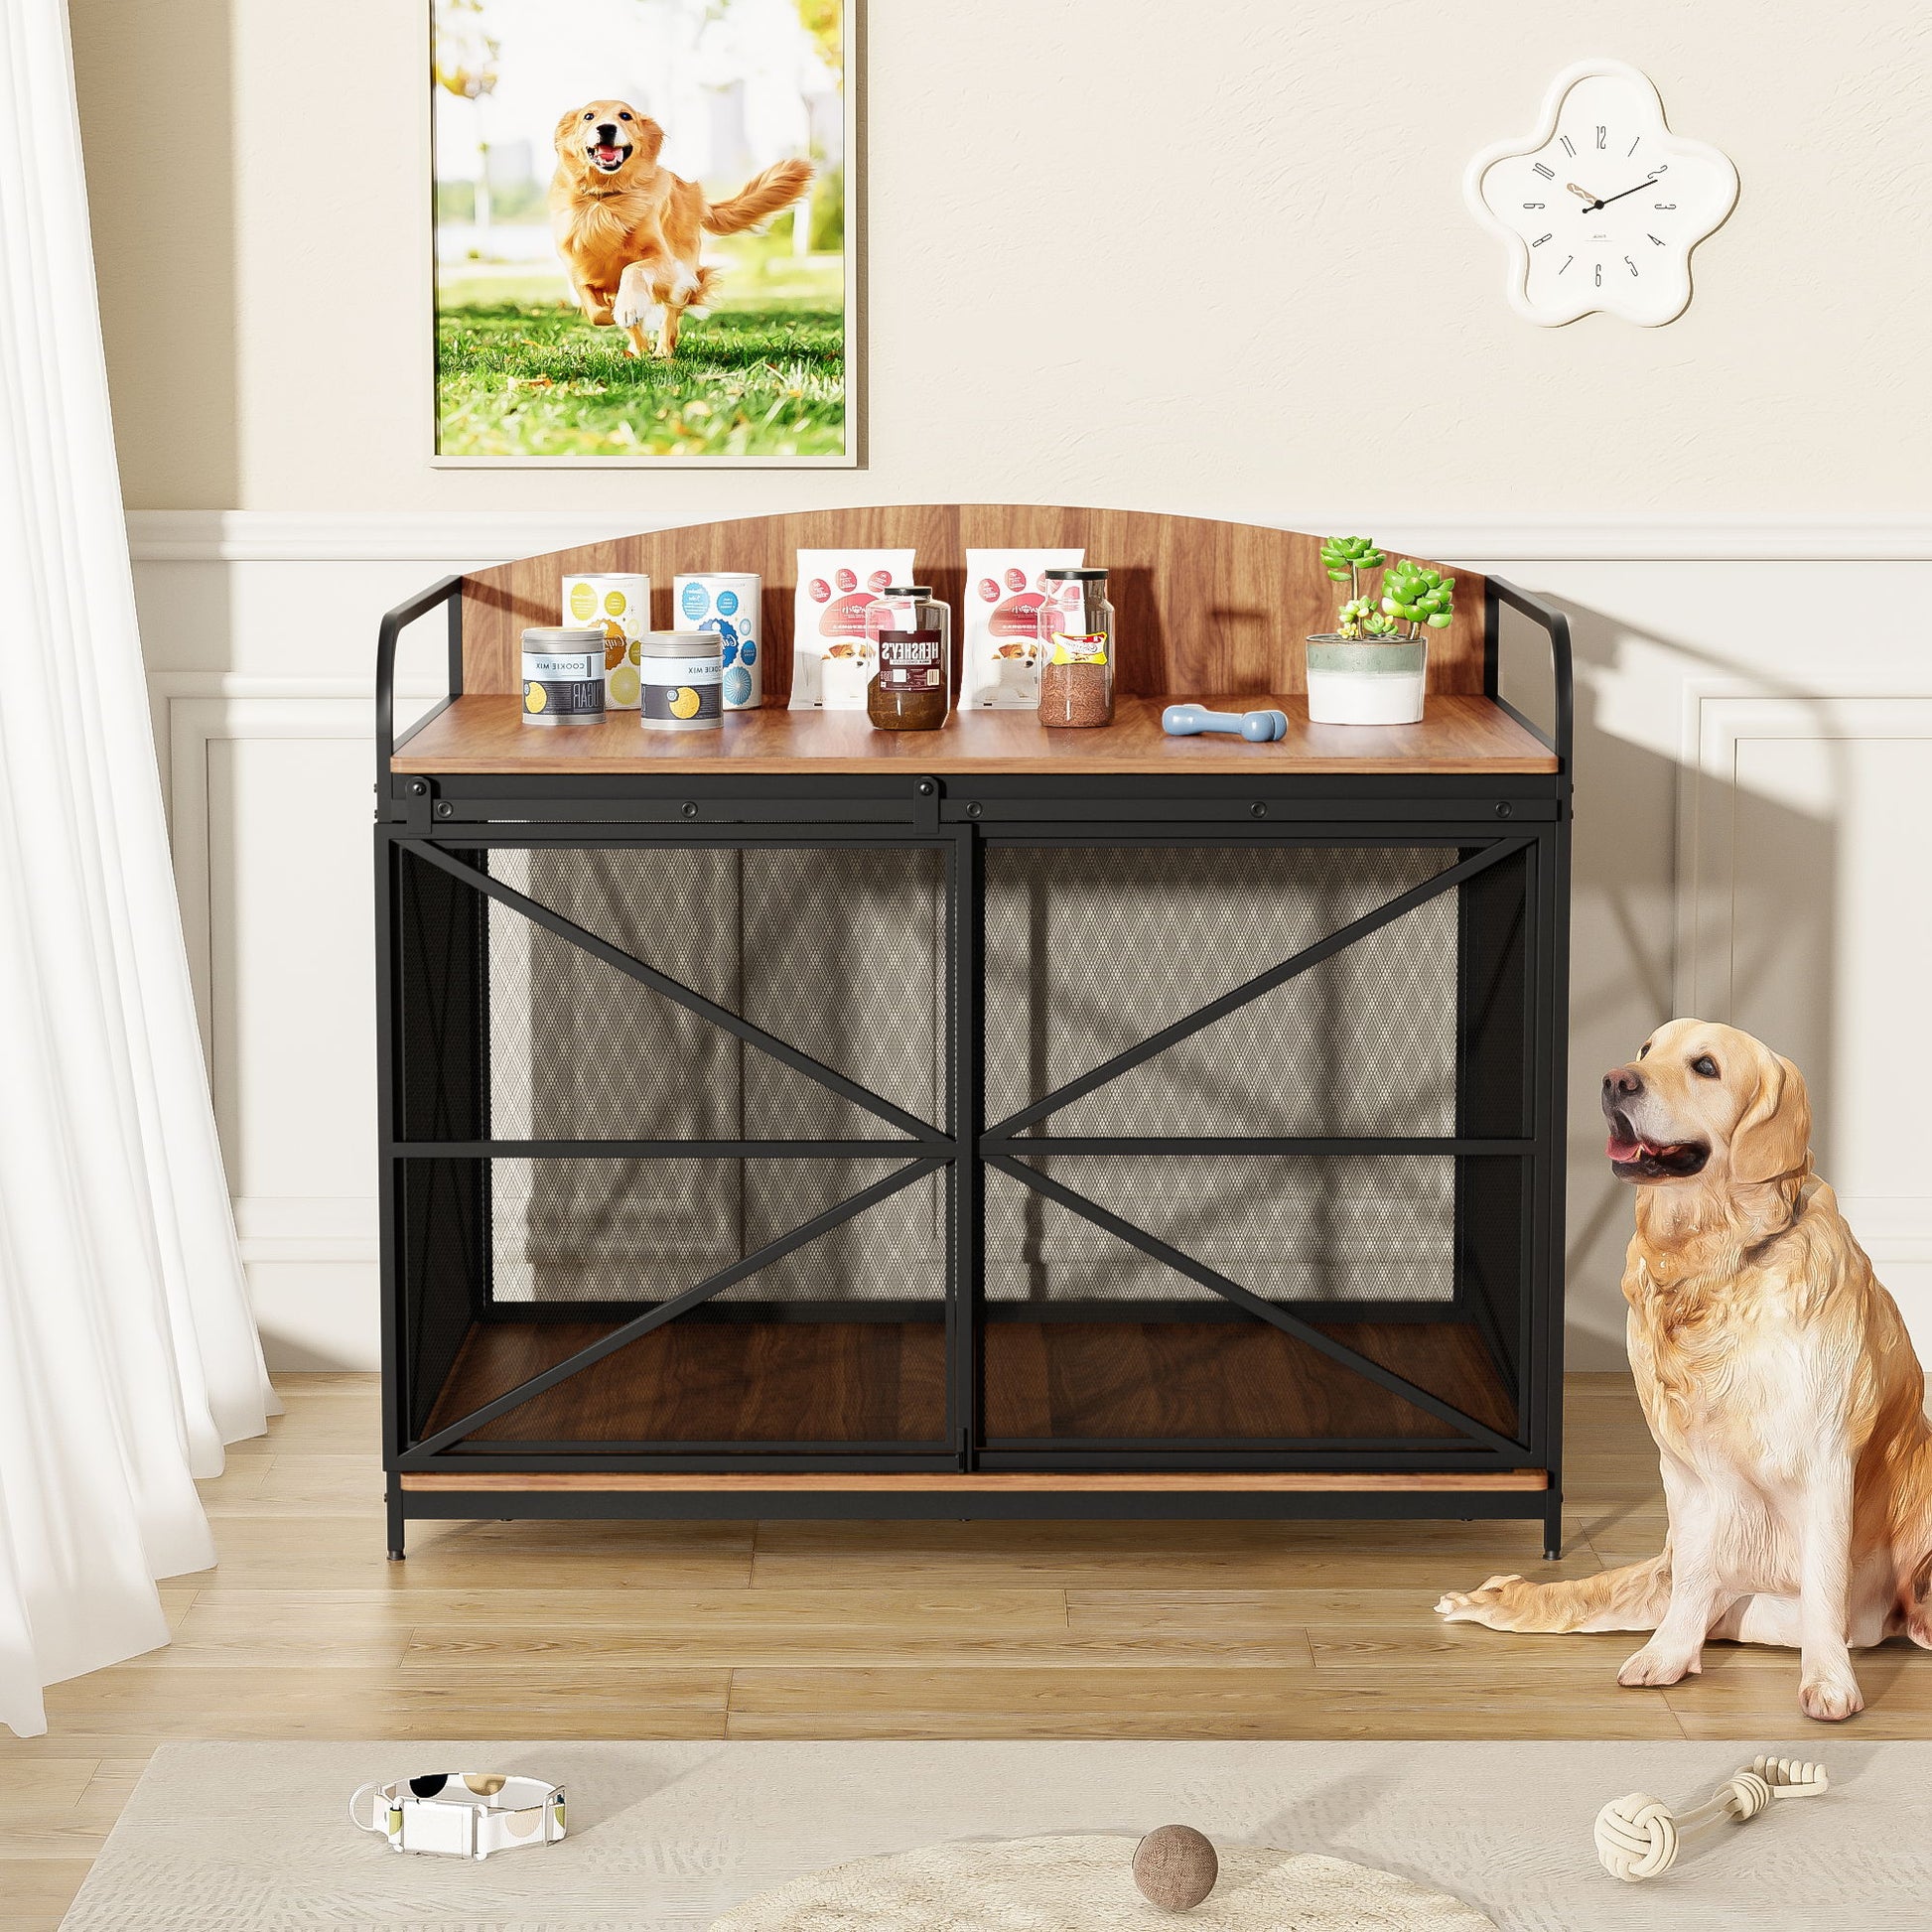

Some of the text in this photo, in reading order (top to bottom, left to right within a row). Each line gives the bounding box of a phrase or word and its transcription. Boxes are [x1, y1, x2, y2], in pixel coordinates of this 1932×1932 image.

[1560, 135, 1577, 159] 11
[1595, 125, 1606, 150] 12
[1627, 136, 1640, 158] 1
[1532, 162, 1556, 181] 10
[1647, 164, 1669, 180] 2
[1522, 202, 1546, 210] 9
[1532, 232, 1553, 248] 8
[1646, 233, 1666, 246] 4
[1558, 254, 1574, 275] 7
[1623, 255, 1639, 277] 5
[1594, 263, 1602, 288] 6
